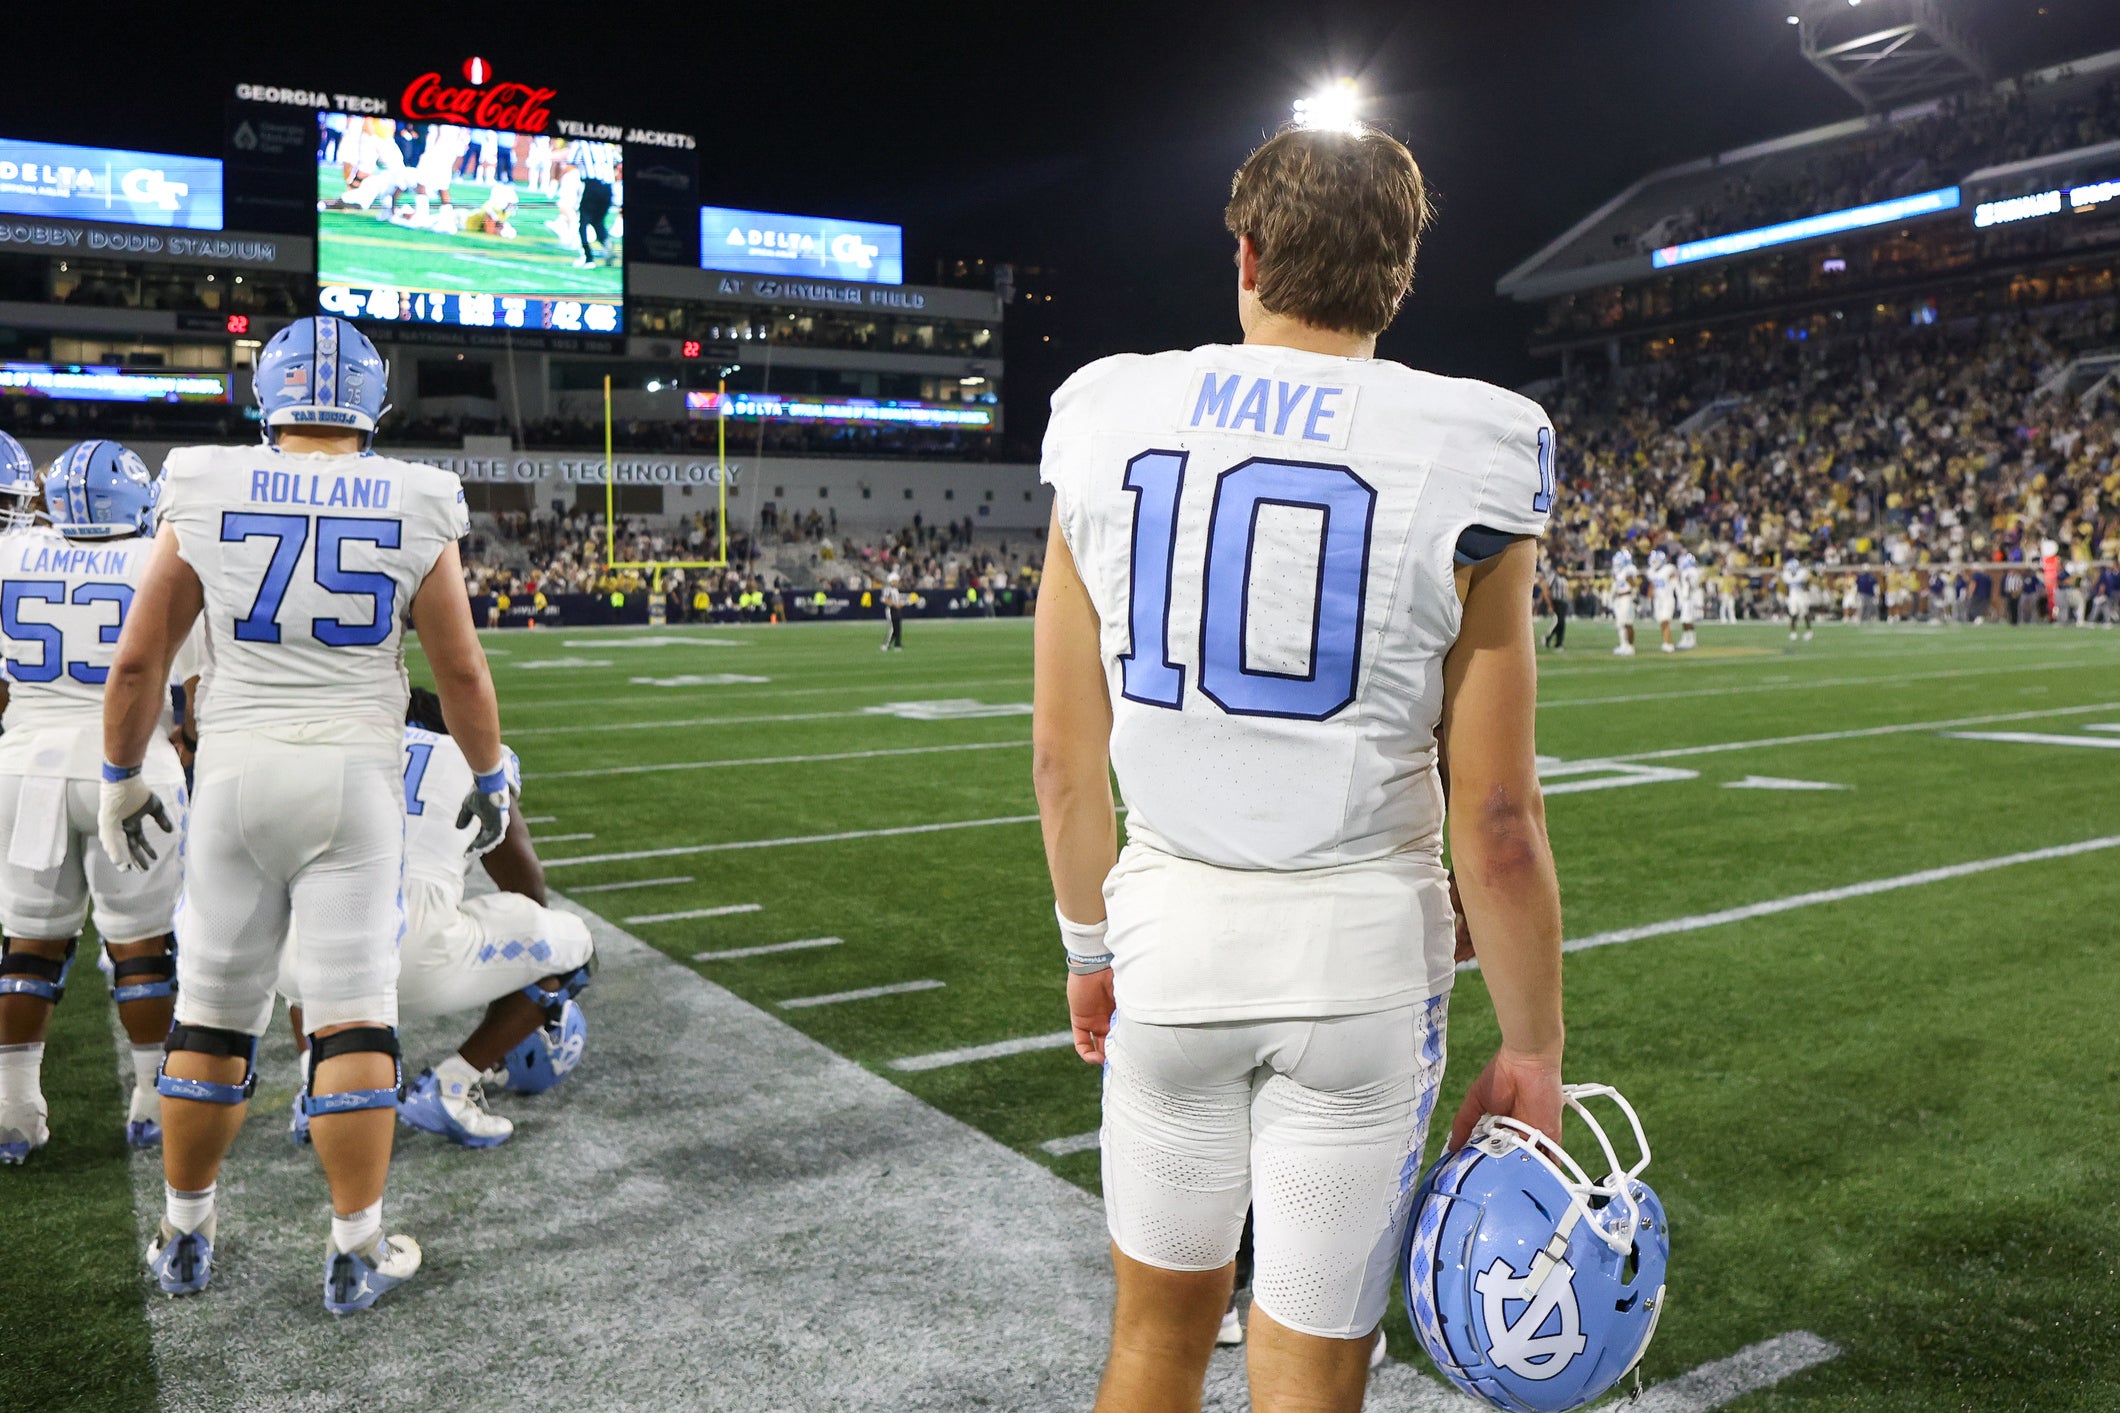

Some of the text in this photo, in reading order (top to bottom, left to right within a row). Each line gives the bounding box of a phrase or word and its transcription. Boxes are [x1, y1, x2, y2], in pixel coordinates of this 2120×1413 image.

[235, 83, 388, 114] GEORGIA TECH
[401, 72, 556, 132] Coca-Cola
[556, 119, 696, 150] YELLOW JACKETS
[0, 161, 96, 187] DELTA
[87, 229, 164, 253] DODD
[168, 236, 276, 261] STADIUM
[748, 229, 815, 250] DELTA
[718, 278, 745, 296] AT
[869, 289, 927, 309] FIELD
[1190, 372, 1343, 442] MAYE
[512, 458, 552, 484] OF
[559, 458, 743, 485] TECHNOLOGY
[1533, 427, 1557, 515] 1
[251, 470, 391, 509] ROLLAND
[20, 548, 128, 574] LAMPKIN
[220, 511, 402, 647] 75
[1117, 447, 1378, 722] 10
[1, 579, 136, 684] 53
